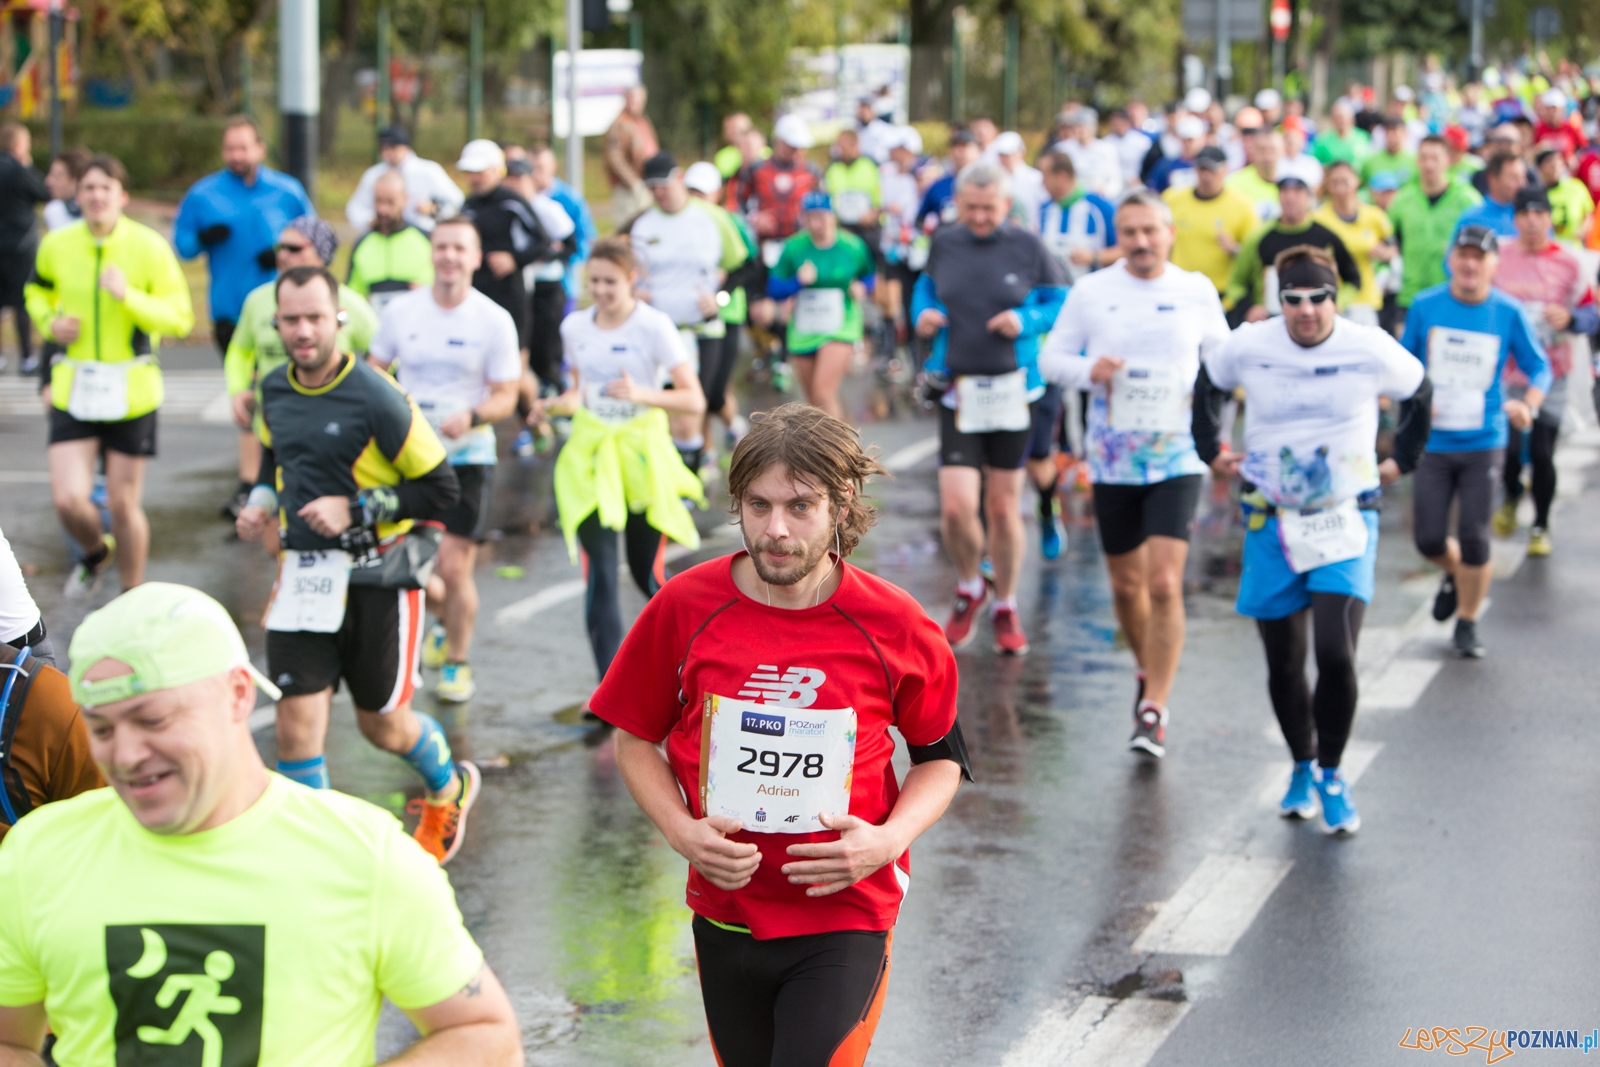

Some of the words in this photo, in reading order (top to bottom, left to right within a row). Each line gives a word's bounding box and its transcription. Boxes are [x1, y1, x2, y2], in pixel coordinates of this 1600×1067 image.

[759, 719, 782, 731] PKO
[788, 727, 825, 735] maraton
[737, 746, 824, 779] 2978
[756, 783, 800, 797] Adrian
